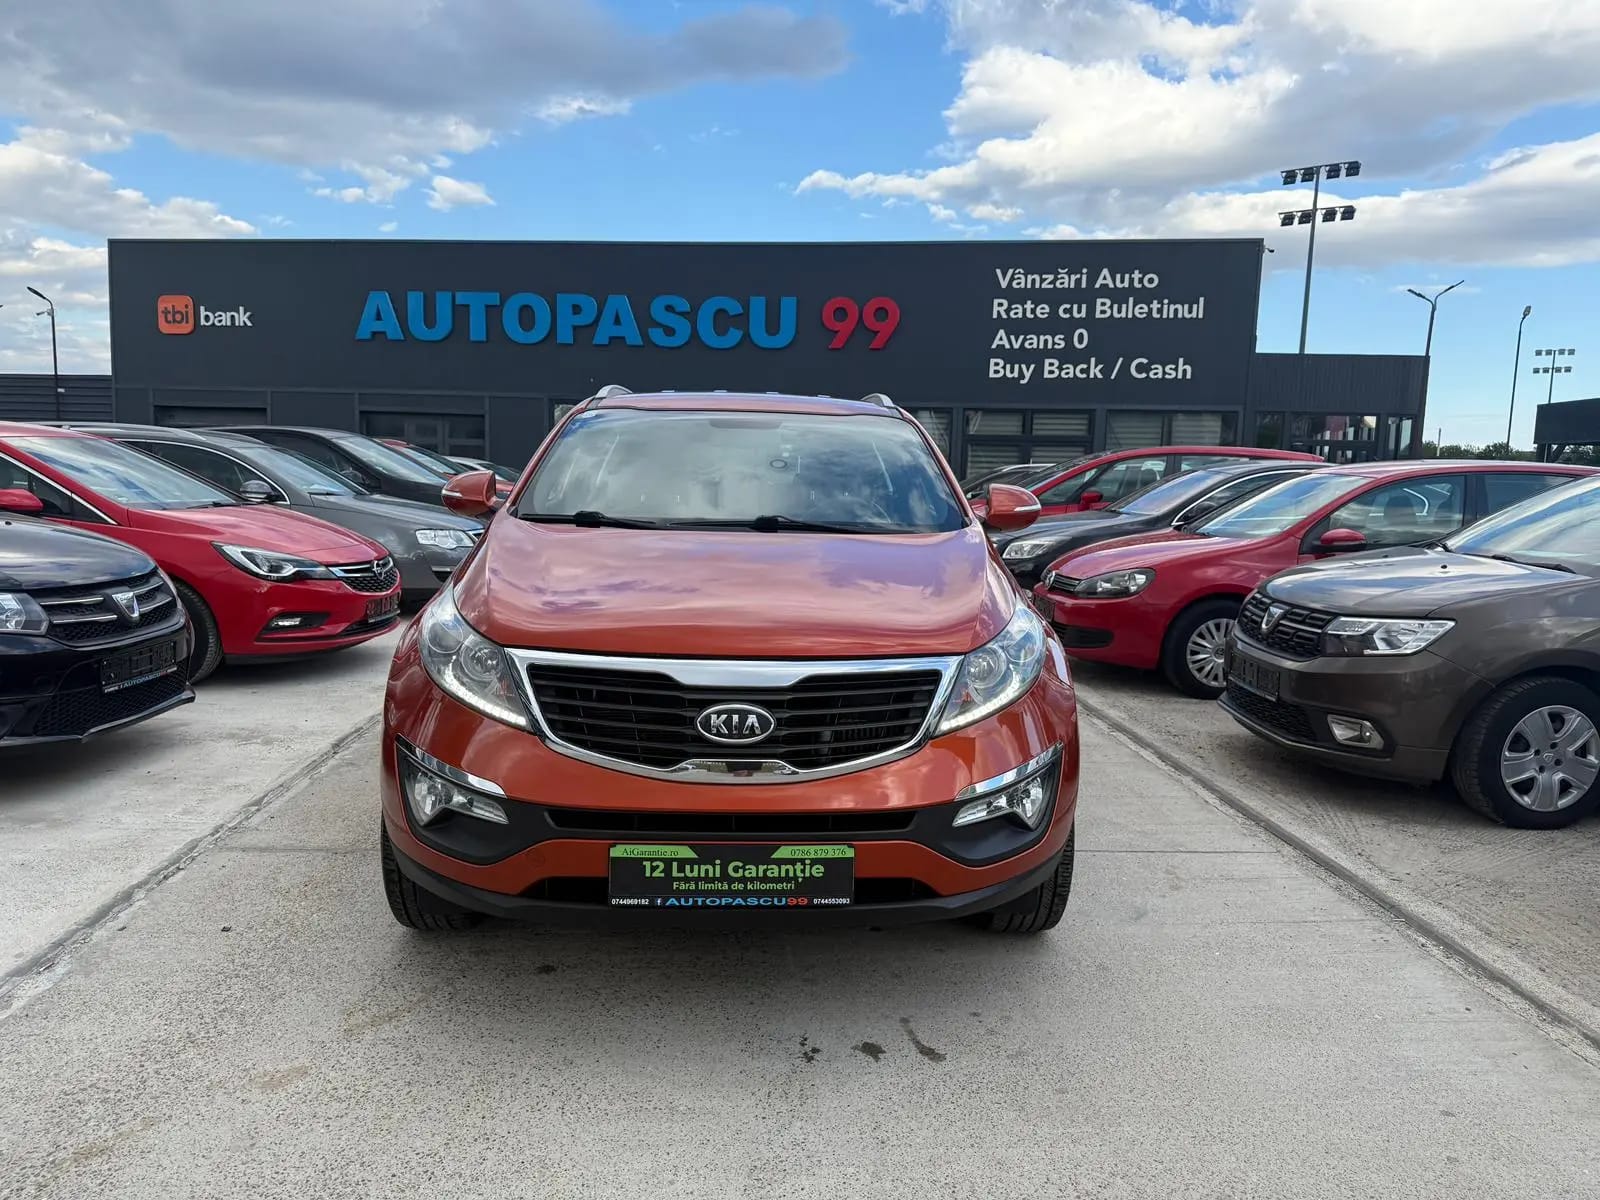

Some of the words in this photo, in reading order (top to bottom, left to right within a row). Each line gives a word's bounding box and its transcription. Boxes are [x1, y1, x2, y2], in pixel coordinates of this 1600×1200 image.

[994, 267, 1088, 289] Vânzări
[1094, 267, 1159, 289] Auto
[161, 303, 190, 325] tbi
[199, 305, 253, 327] bank
[991, 298, 1051, 319] Rate
[1057, 302, 1087, 319] cu
[1094, 297, 1205, 319] Buletinul
[355, 290, 798, 350] AUTOPASCU
[821, 296, 901, 351] 99
[991, 329, 1067, 350] Avans
[988, 358, 1036, 384] Buy
[1042, 357, 1104, 379] Back
[1110, 357, 1124, 380] /
[1129, 357, 1193, 380] Cash
[710, 714, 761, 734] KIA
[621, 847, 680, 857] AiGarantie.ro
[790, 848, 811, 857] 0786
[813, 848, 829, 857] 879
[830, 847, 847, 857] 376
[642, 860, 665, 878] 12
[671, 859, 721, 878] Luni
[727, 859, 825, 883] Garanție
[673, 881, 696, 891] Fără
[698, 880, 729, 891] limită
[731, 881, 745, 891] de
[747, 881, 795, 891] kilometri
[665, 897, 808, 906] AUTOPASCU99
